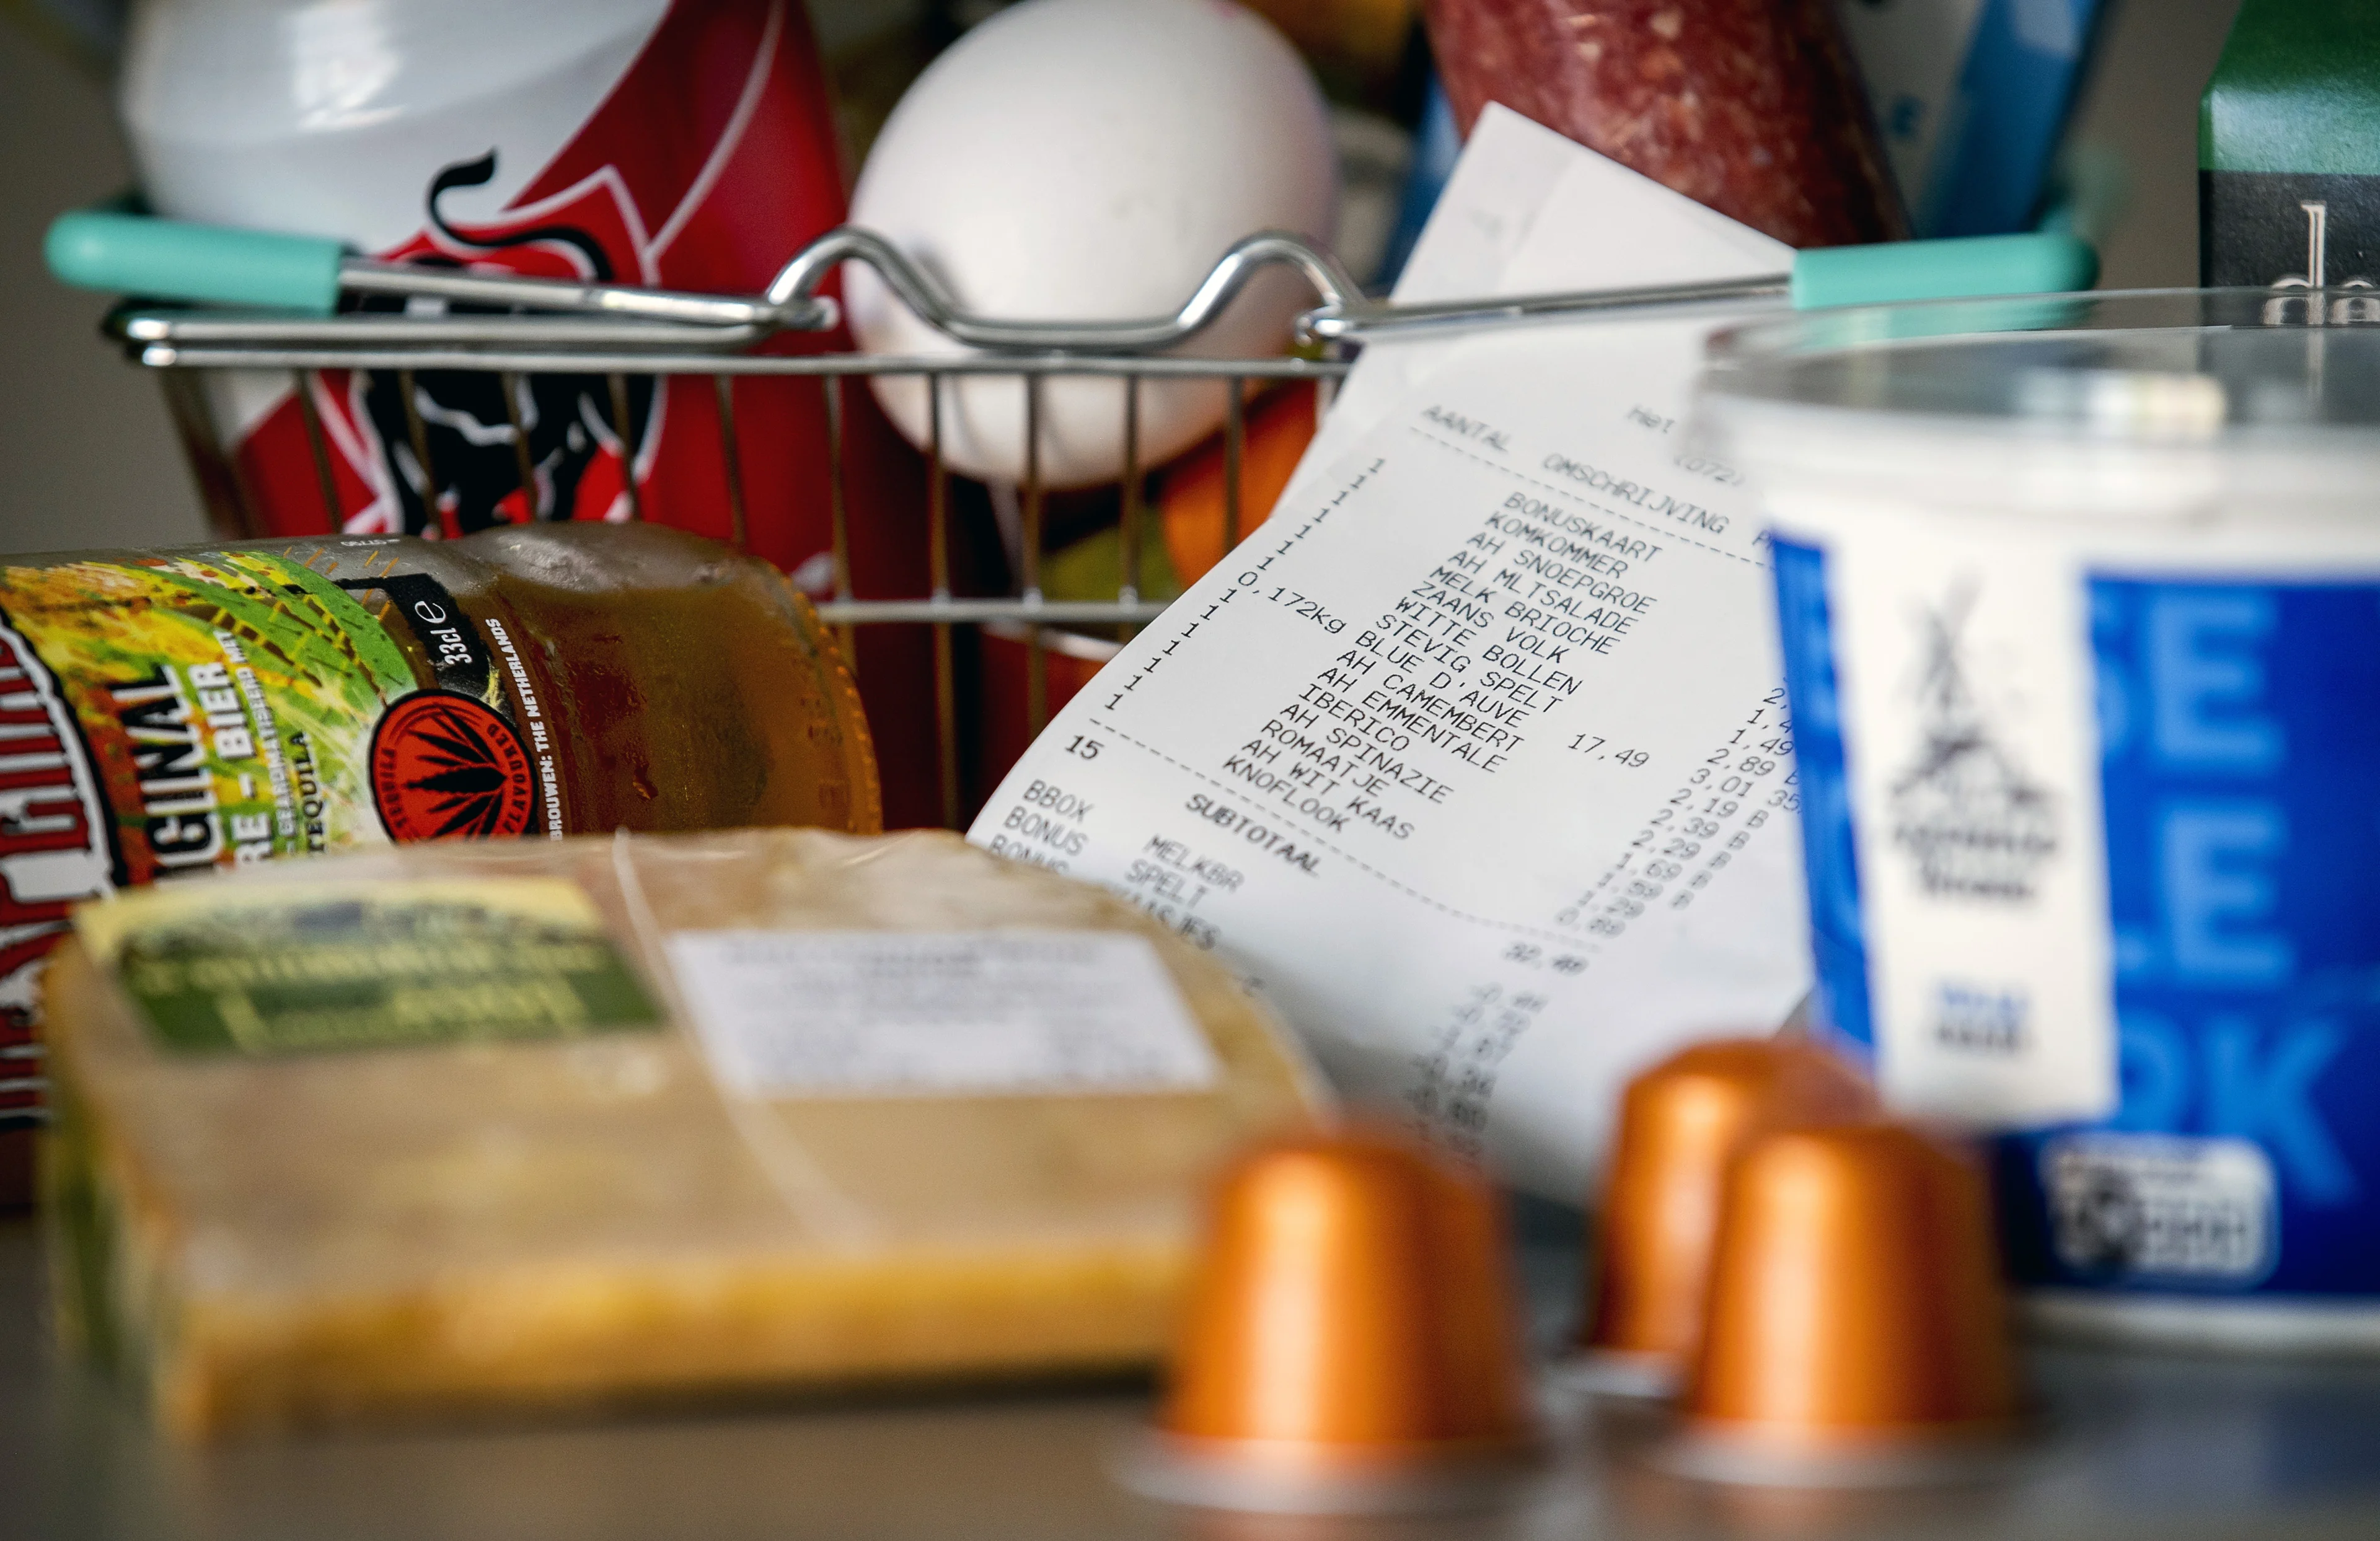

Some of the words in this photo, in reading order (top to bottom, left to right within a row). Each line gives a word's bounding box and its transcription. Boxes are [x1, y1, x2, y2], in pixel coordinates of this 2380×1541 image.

[1368, 458, 1386, 473] 1
[1485, 512, 1629, 579] KOMKOMMER
[1422, 405, 1510, 452] AANTAL
[1543, 454, 1730, 534] OMSCHRIJVING
[1503, 491, 1663, 563] BONUSKAART
[1313, 508, 1331, 523] 1
[1429, 566, 1499, 603] MELK
[1504, 601, 1621, 655] BRIOCHE
[1331, 491, 1349, 506] 1
[1448, 551, 1487, 575] AH
[1493, 569, 1639, 636] MLTSALADE
[1350, 475, 1368, 490] 1
[1468, 532, 1502, 555] AH
[1514, 550, 1657, 615] SNOEPGROE
[218, 632, 249, 664] MET
[430, 627, 472, 665] 33cl
[485, 618, 540, 717] NETHERLANDS
[1181, 622, 1201, 638] 1
[1298, 683, 1410, 751] IBERICO
[1238, 571, 1347, 634] 0,172kg
[1355, 631, 1426, 674] BLUE
[1429, 672, 1530, 728] D'AUVE
[1567, 733, 1651, 768] 17,49
[1689, 768, 1754, 797] 3,01
[1256, 556, 1275, 571] 1
[1376, 613, 1471, 673] STEVIG
[1480, 672, 1563, 713] SPELT
[1707, 749, 1776, 776] 2,89
[1276, 540, 1294, 555] 1
[1395, 597, 1478, 647] WITTE
[1482, 644, 1584, 695] BOLLEN
[1729, 729, 1794, 756] 1,49
[1294, 524, 1312, 539] 1
[1412, 581, 1494, 628] ZAANS
[1506, 626, 1571, 663] VOLK
[1747, 709, 1792, 734] 1,4
[112, 664, 224, 867] GINAL
[187, 662, 256, 758] BIER
[530, 721, 549, 752] THE
[1104, 693, 1123, 710] 1
[1222, 755, 1351, 833] KNOFLOOK
[1124, 675, 1144, 691] 1
[1241, 739, 1282, 764] AH
[1289, 762, 1341, 796] WIT
[1347, 796, 1415, 840] KAAS
[1143, 657, 1162, 674] 1
[1261, 719, 1390, 797] ROMAATJE
[1162, 639, 1181, 656] 1
[1279, 704, 1320, 729] AH
[1326, 728, 1455, 804] SPINAZIE
[1201, 605, 1219, 620] 1
[1317, 667, 1357, 692] AH
[1362, 691, 1508, 773] EMMENTALE
[1650, 809, 1720, 838] 2,39
[1219, 588, 1238, 604] 1
[1336, 649, 1376, 675] AH
[1383, 674, 1525, 752] CAMEMBERT
[1670, 788, 1739, 818] 2,19
[231, 812, 273, 866] RE
[289, 730, 325, 853] TEQUILA
[487, 723, 526, 834] FLAVOURED
[1023, 778, 1095, 824] BBOX
[1066, 735, 1105, 761] 15
[1185, 792, 1321, 879] SUBTOTAAL
[1003, 806, 1089, 857] BONUS
[1142, 833, 1245, 894] MELKBR
[1123, 858, 1209, 909] SPELT
